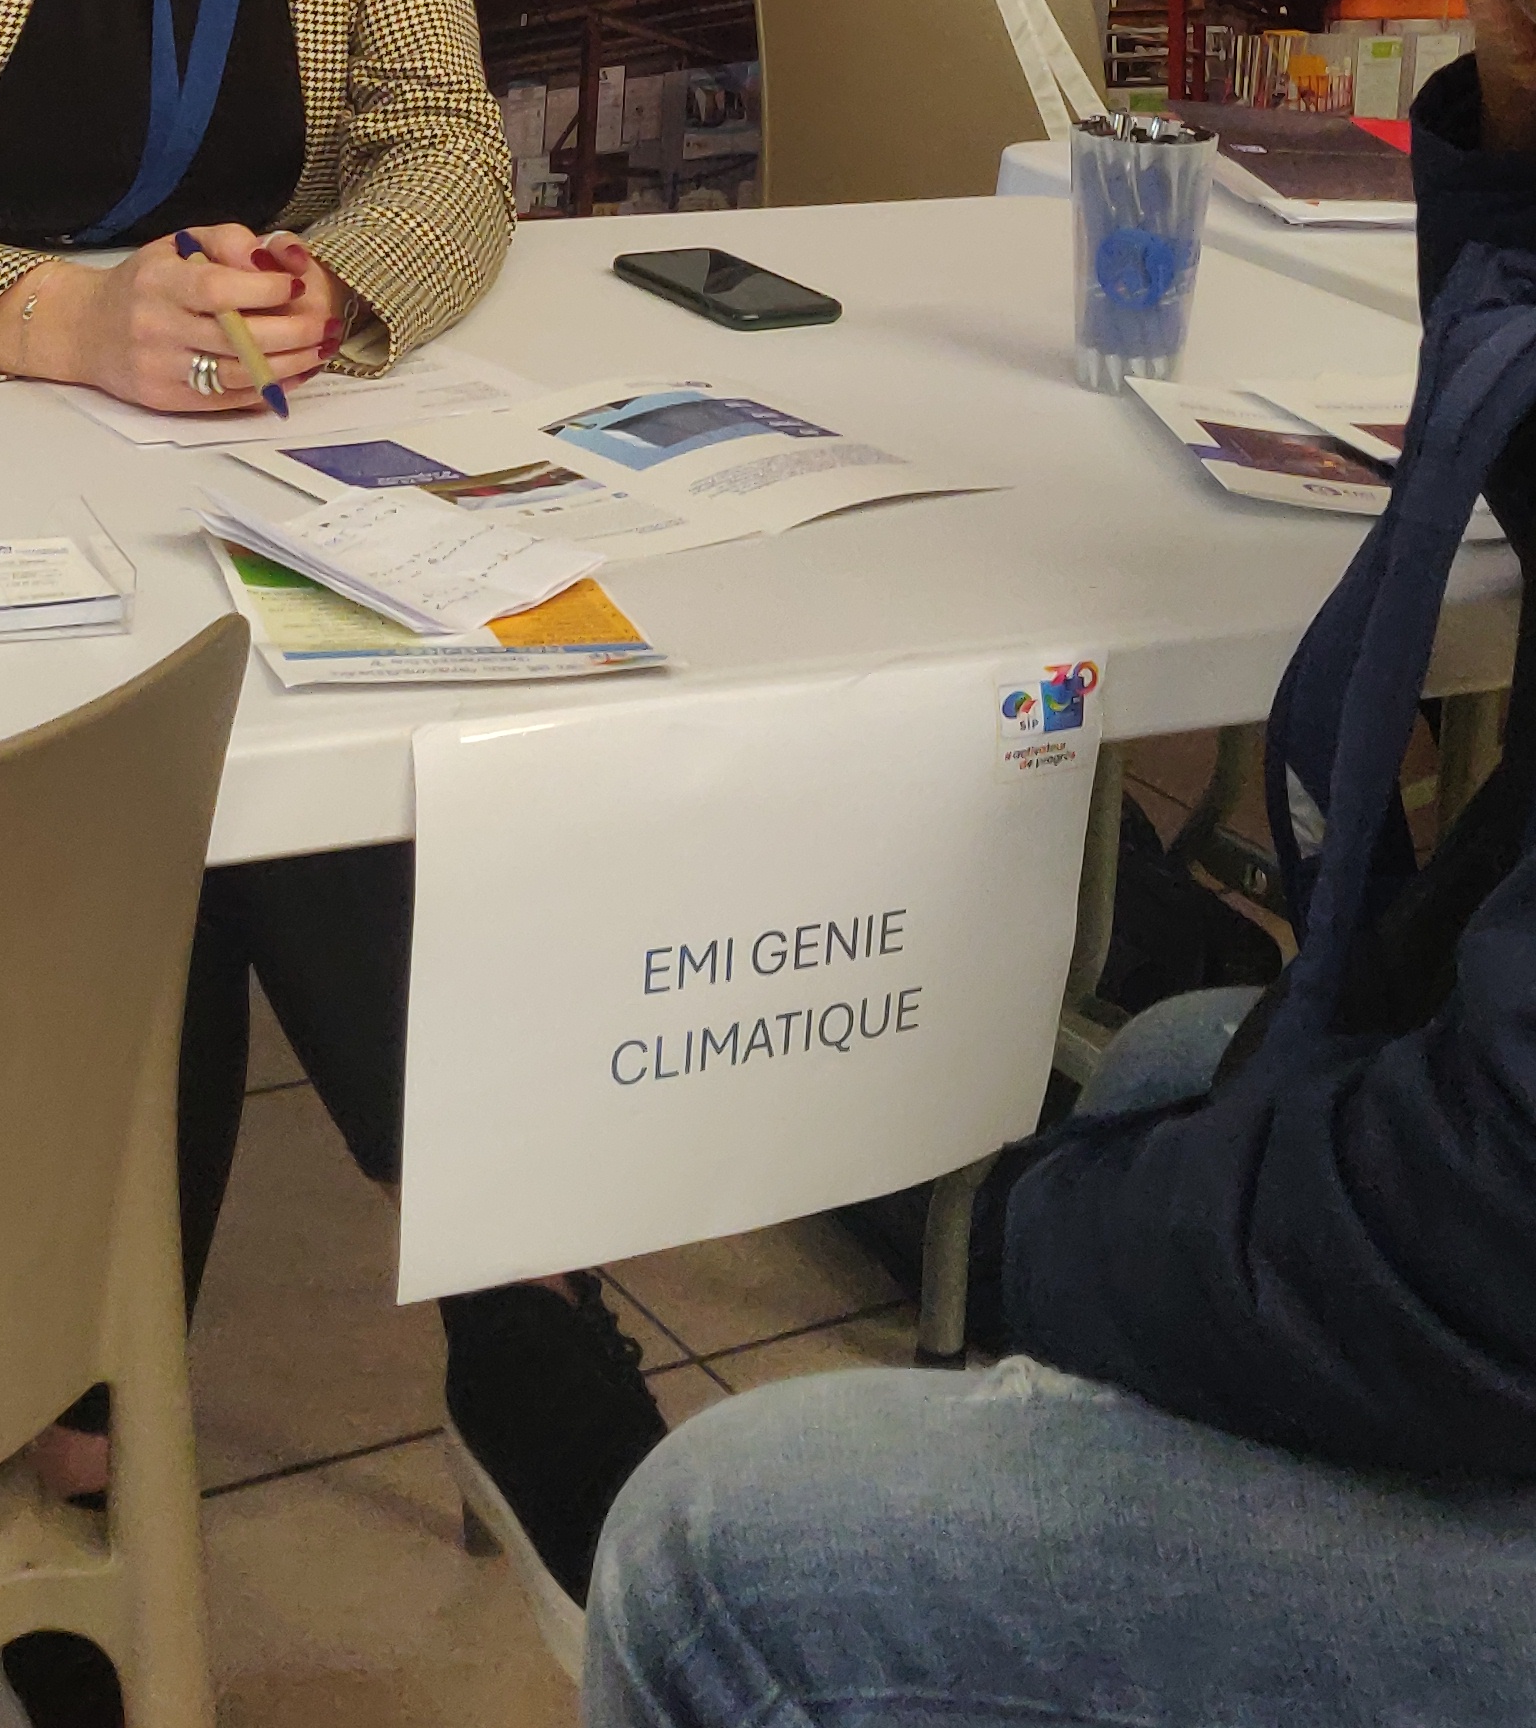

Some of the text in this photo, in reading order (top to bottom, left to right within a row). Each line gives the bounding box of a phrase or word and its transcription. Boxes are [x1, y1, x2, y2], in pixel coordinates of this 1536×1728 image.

[642, 908, 908, 995] EMI GENIE
[610, 986, 923, 1086] CLIMATIQUE
